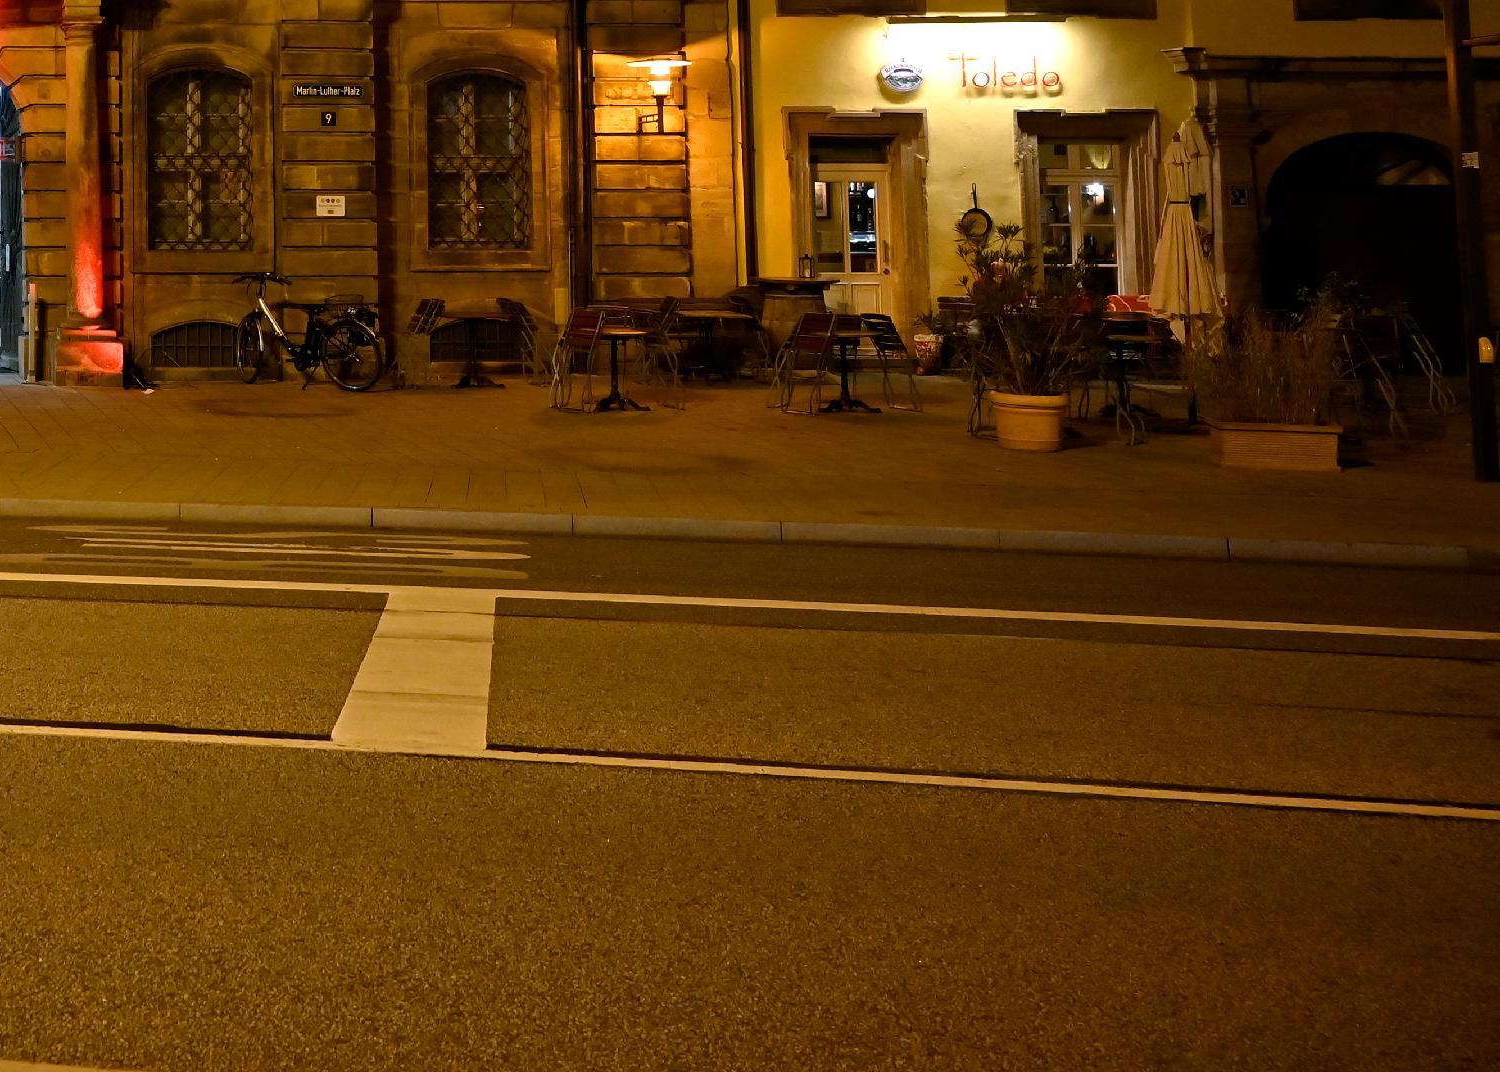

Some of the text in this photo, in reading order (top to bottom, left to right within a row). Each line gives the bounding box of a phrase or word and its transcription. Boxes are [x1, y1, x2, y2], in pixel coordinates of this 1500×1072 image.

[947, 52, 1060, 88] Toledo
[296, 85, 361, 96] Martin-Luther-Platz
[325, 113, 332, 124] 9
